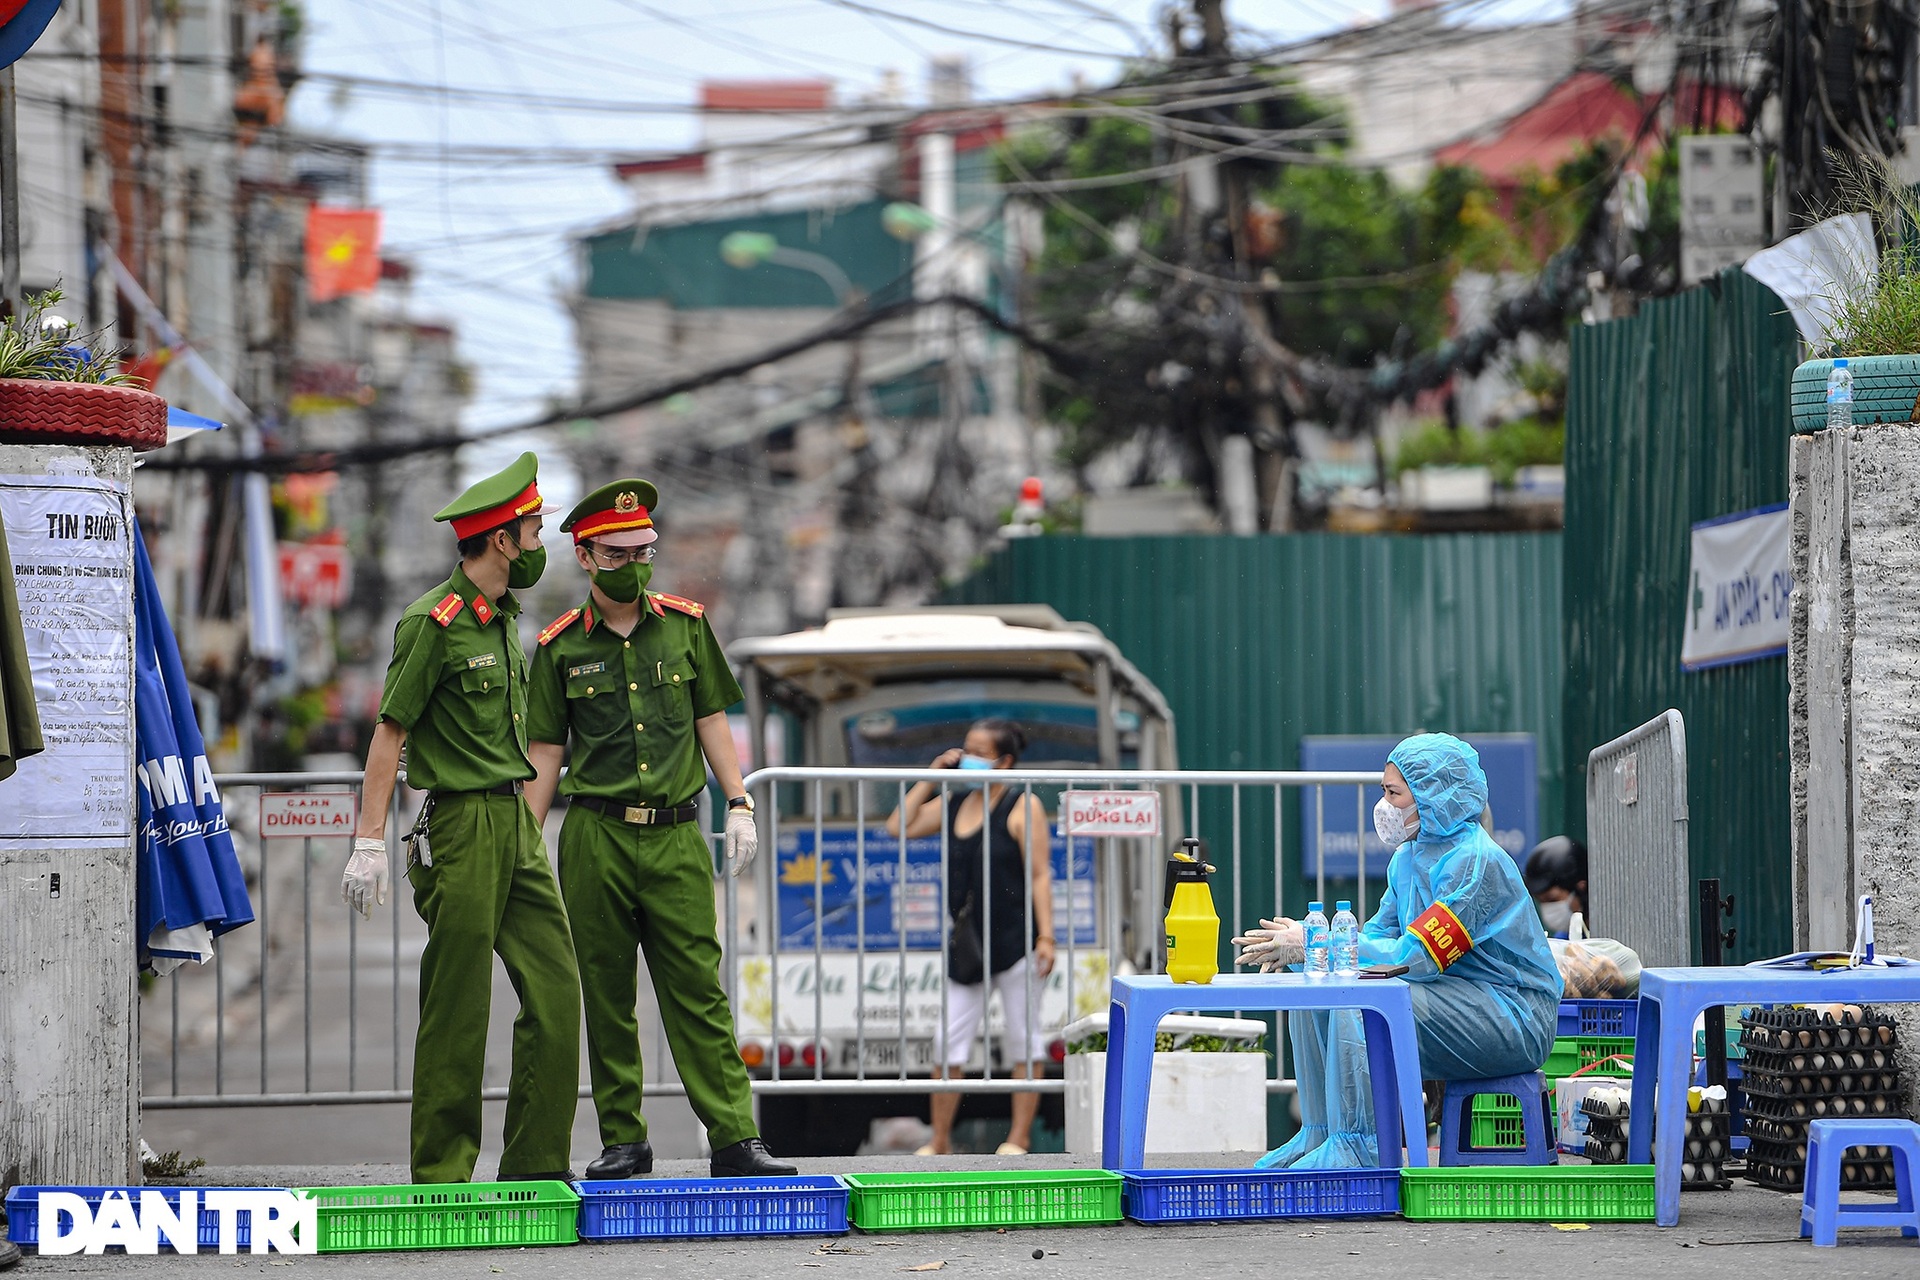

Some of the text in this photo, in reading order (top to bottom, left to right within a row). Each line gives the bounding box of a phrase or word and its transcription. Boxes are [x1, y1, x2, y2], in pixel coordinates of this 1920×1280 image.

[46, 513, 78, 540] TIN
[37, 561, 62, 576] CHÚNG
[267, 809, 350, 828] DỪNG LẠI
[1074, 806, 1152, 826] DỪNG LẠI
[1423, 916, 1454, 950] BẢO
